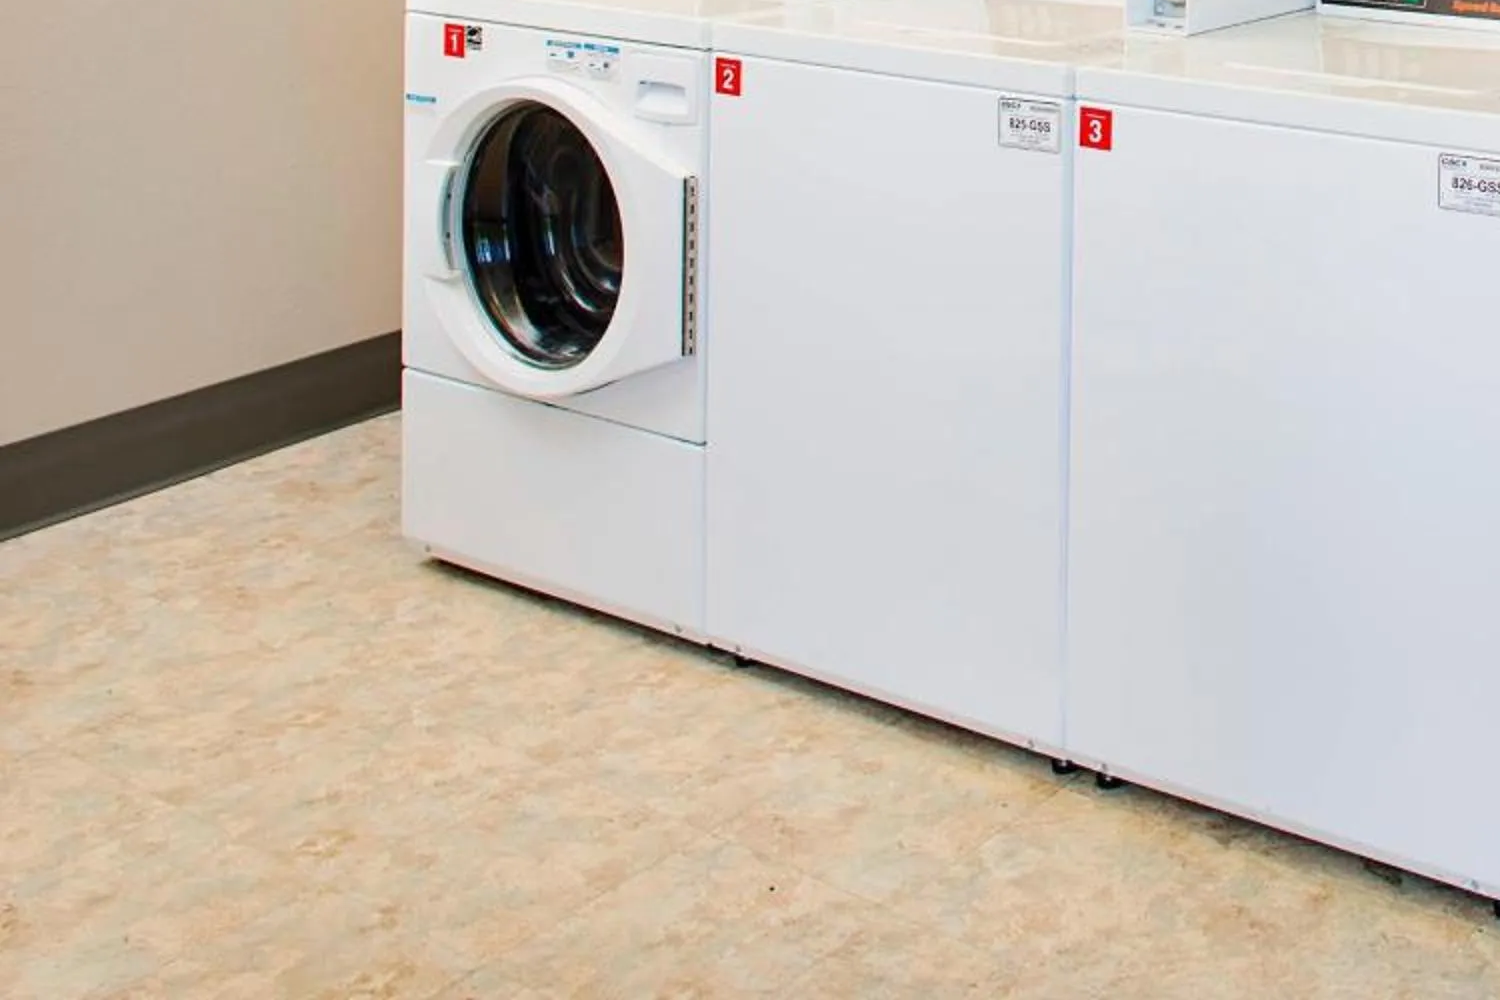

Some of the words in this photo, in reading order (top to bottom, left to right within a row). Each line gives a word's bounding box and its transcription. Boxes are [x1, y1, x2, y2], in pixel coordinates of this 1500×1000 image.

[451, 33, 458, 52] 1
[723, 68, 736, 89] 2
[1088, 119, 1103, 143] 3
